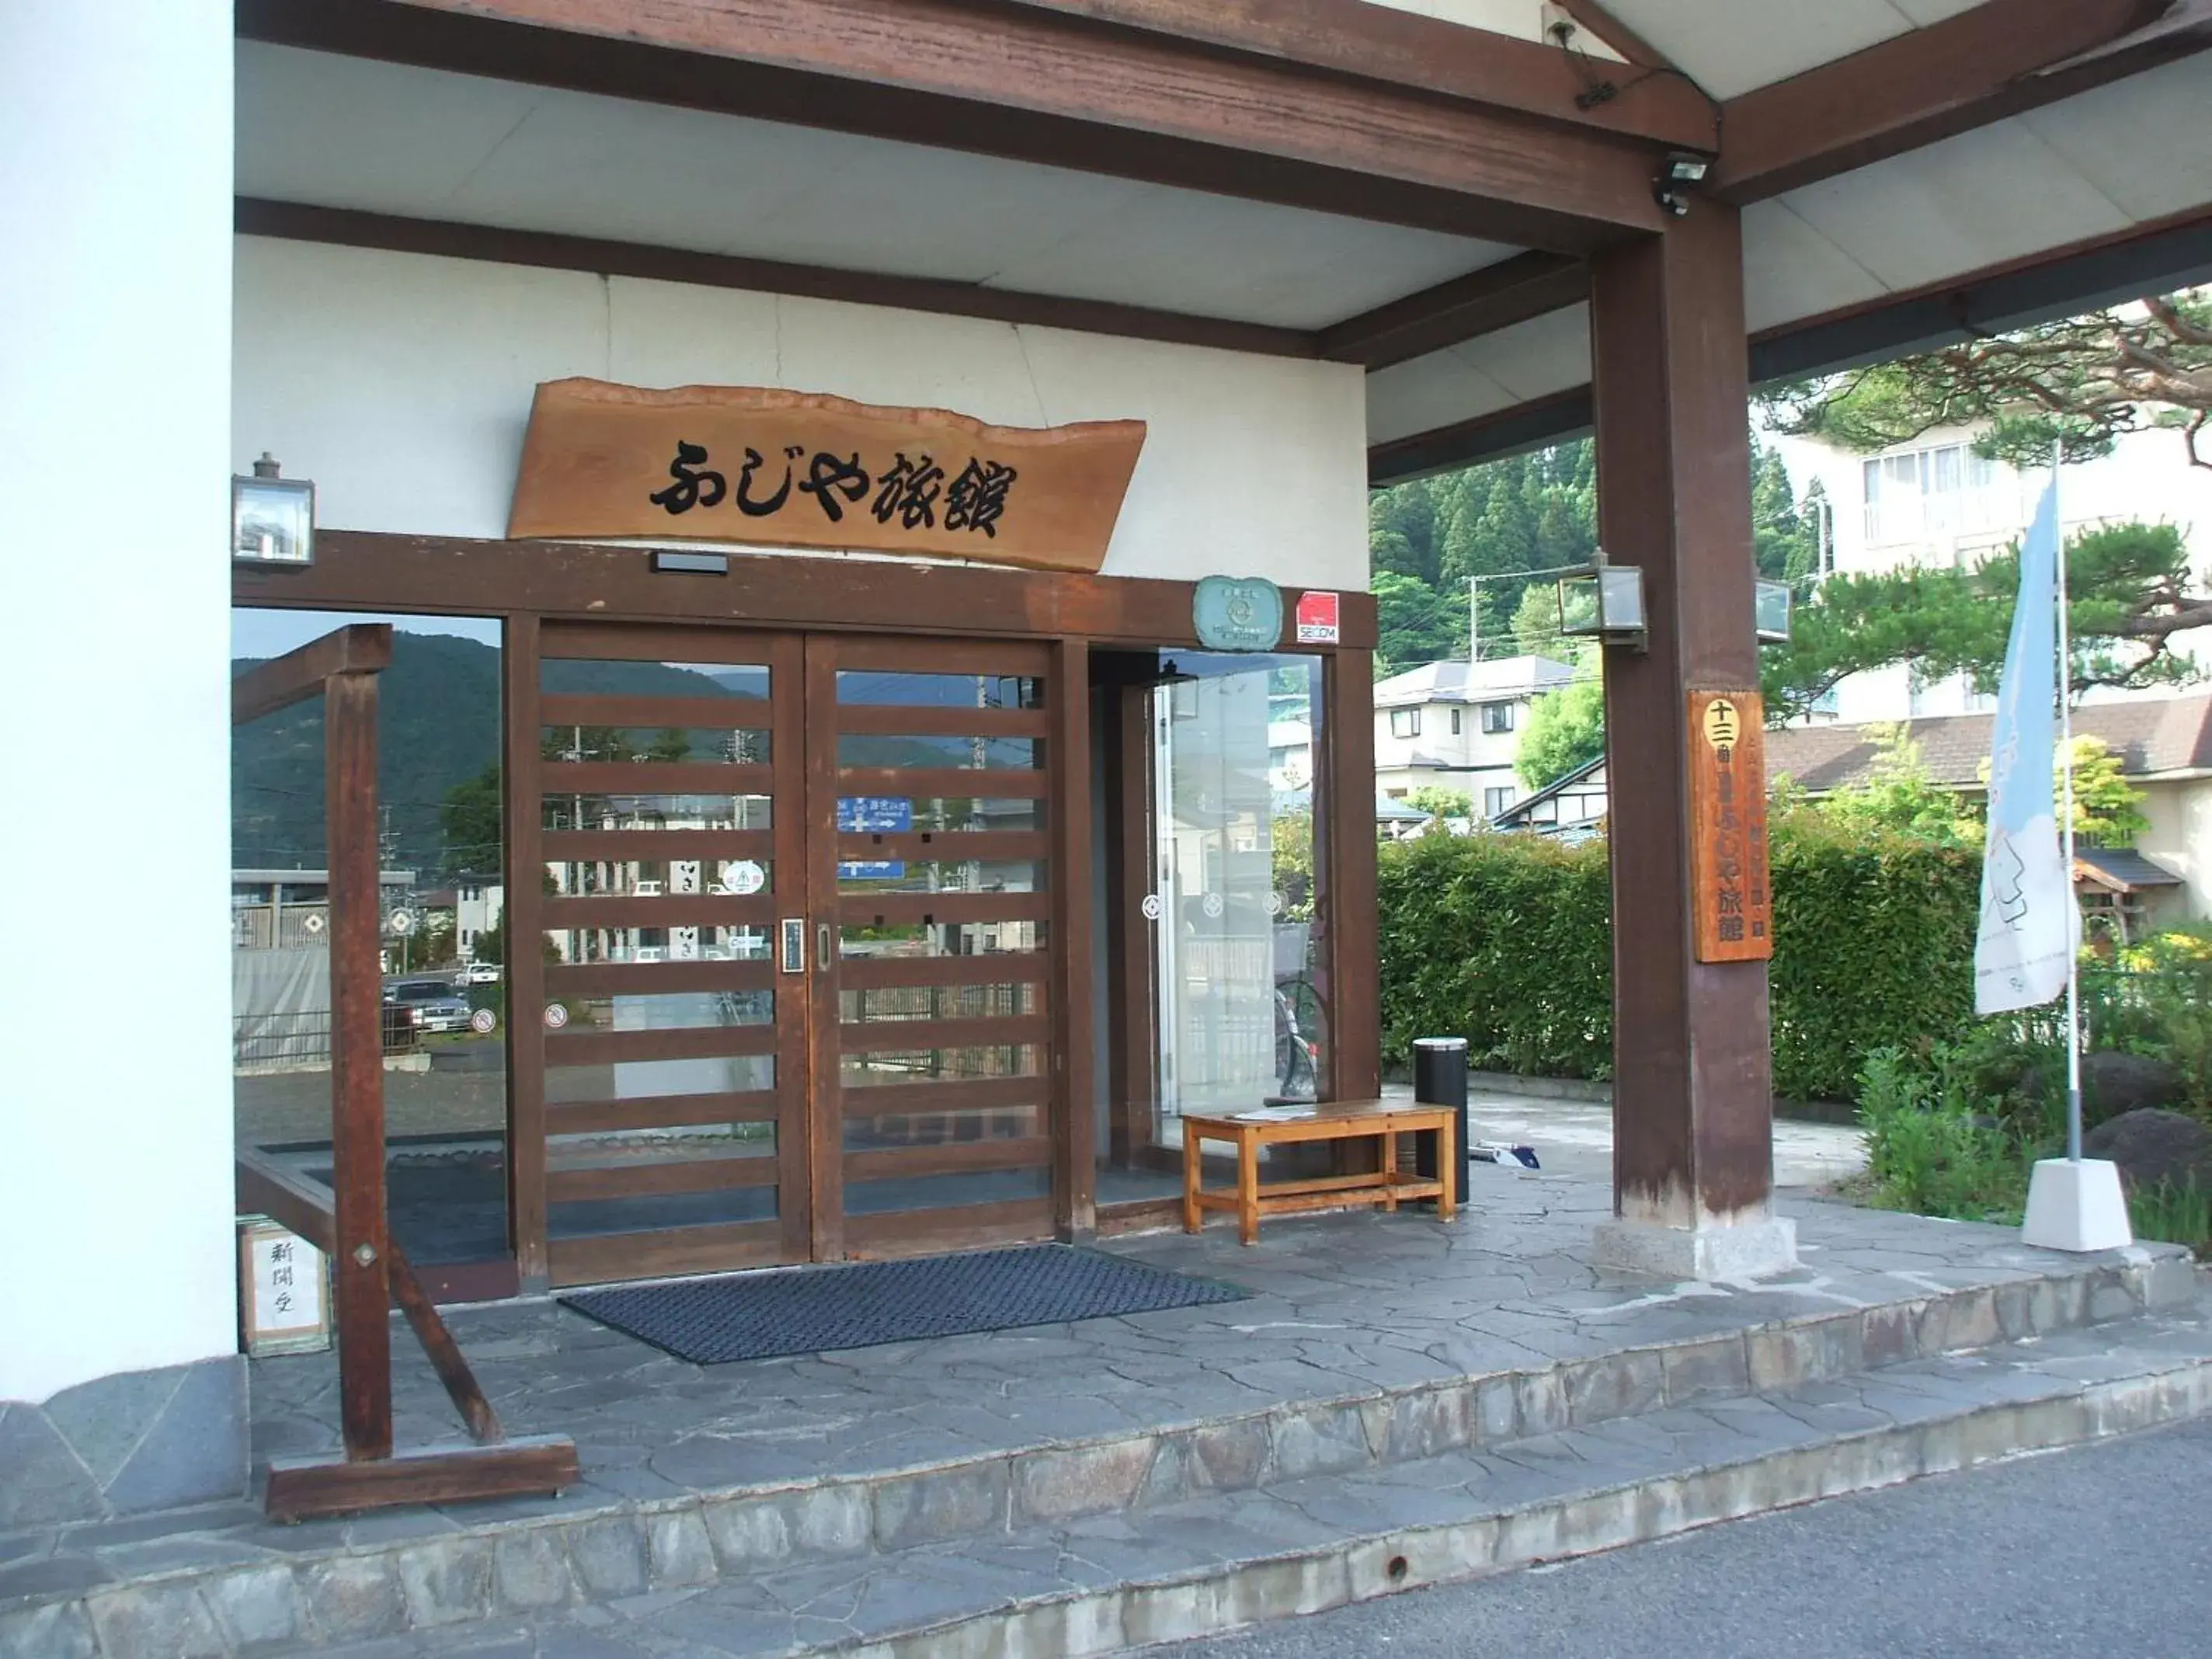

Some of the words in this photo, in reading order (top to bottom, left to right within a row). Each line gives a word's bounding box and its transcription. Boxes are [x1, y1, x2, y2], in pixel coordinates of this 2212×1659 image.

[649, 440, 1017, 539] ふじや旅館
[1300, 626, 1336, 638] SECOM
